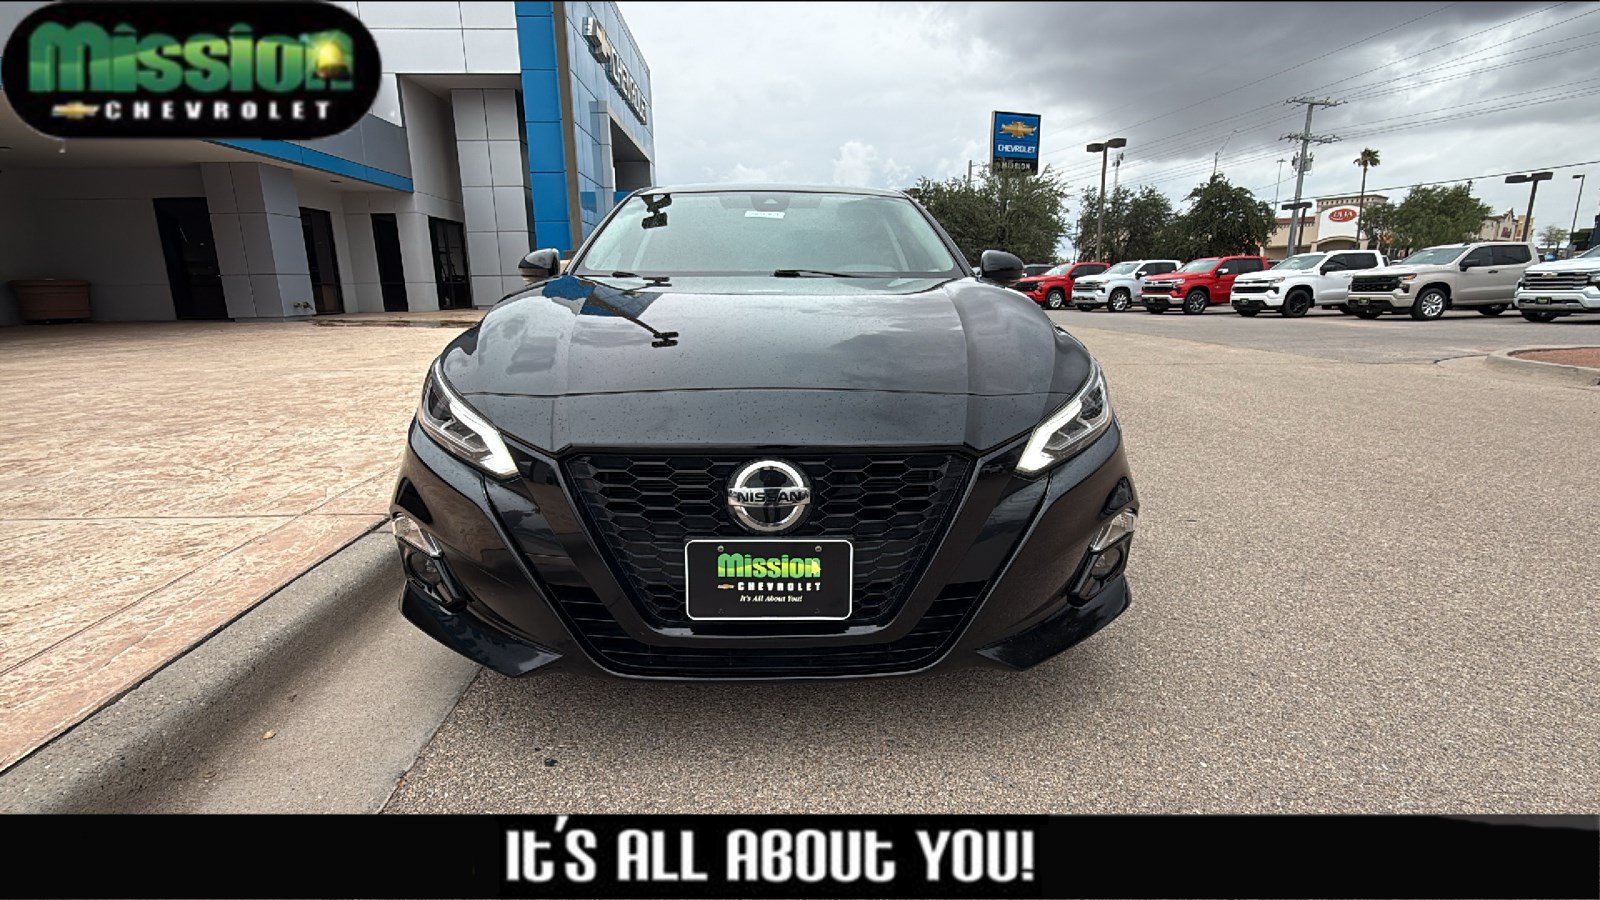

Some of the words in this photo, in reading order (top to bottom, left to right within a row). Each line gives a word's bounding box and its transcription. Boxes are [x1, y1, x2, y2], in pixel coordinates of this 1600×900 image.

[997, 144, 1036, 153] CHEVROLET
[737, 491, 802, 503] NISSAN
[718, 553, 821, 578] Mission
[737, 582, 821, 591] CHEVROLET
